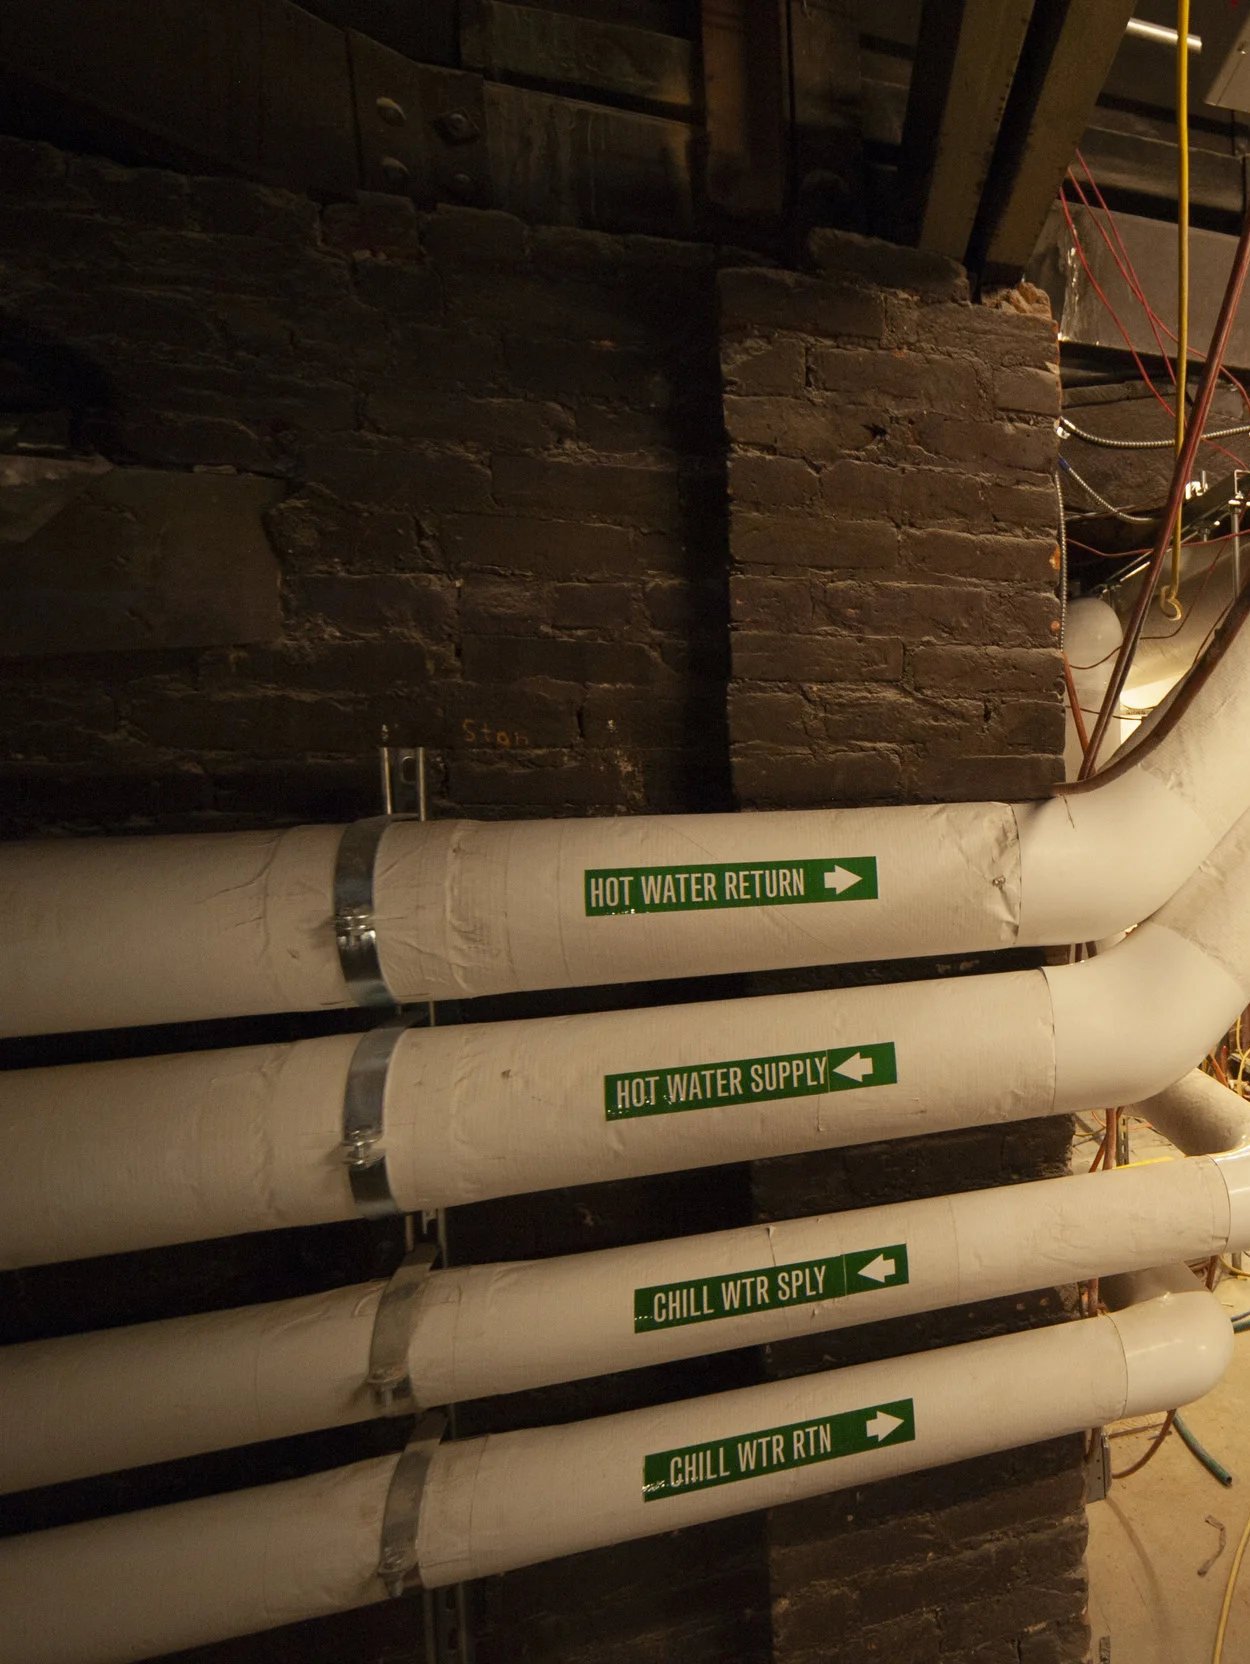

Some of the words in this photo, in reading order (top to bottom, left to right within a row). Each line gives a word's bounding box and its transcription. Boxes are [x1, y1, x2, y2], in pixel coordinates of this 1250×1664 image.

[591, 876, 634, 908] HOT
[641, 872, 718, 905] WATER
[725, 868, 805, 900] RETURN
[616, 1076, 659, 1109] HOT
[666, 1067, 743, 1104] WATER
[750, 1056, 827, 1093] SUPPLY
[653, 1287, 714, 1323] CHILL
[721, 1276, 769, 1309] WTR
[777, 1265, 826, 1300] SPLY
[669, 1447, 730, 1488] CHILL
[738, 1434, 785, 1472] WTR
[792, 1423, 832, 1460] RTN
